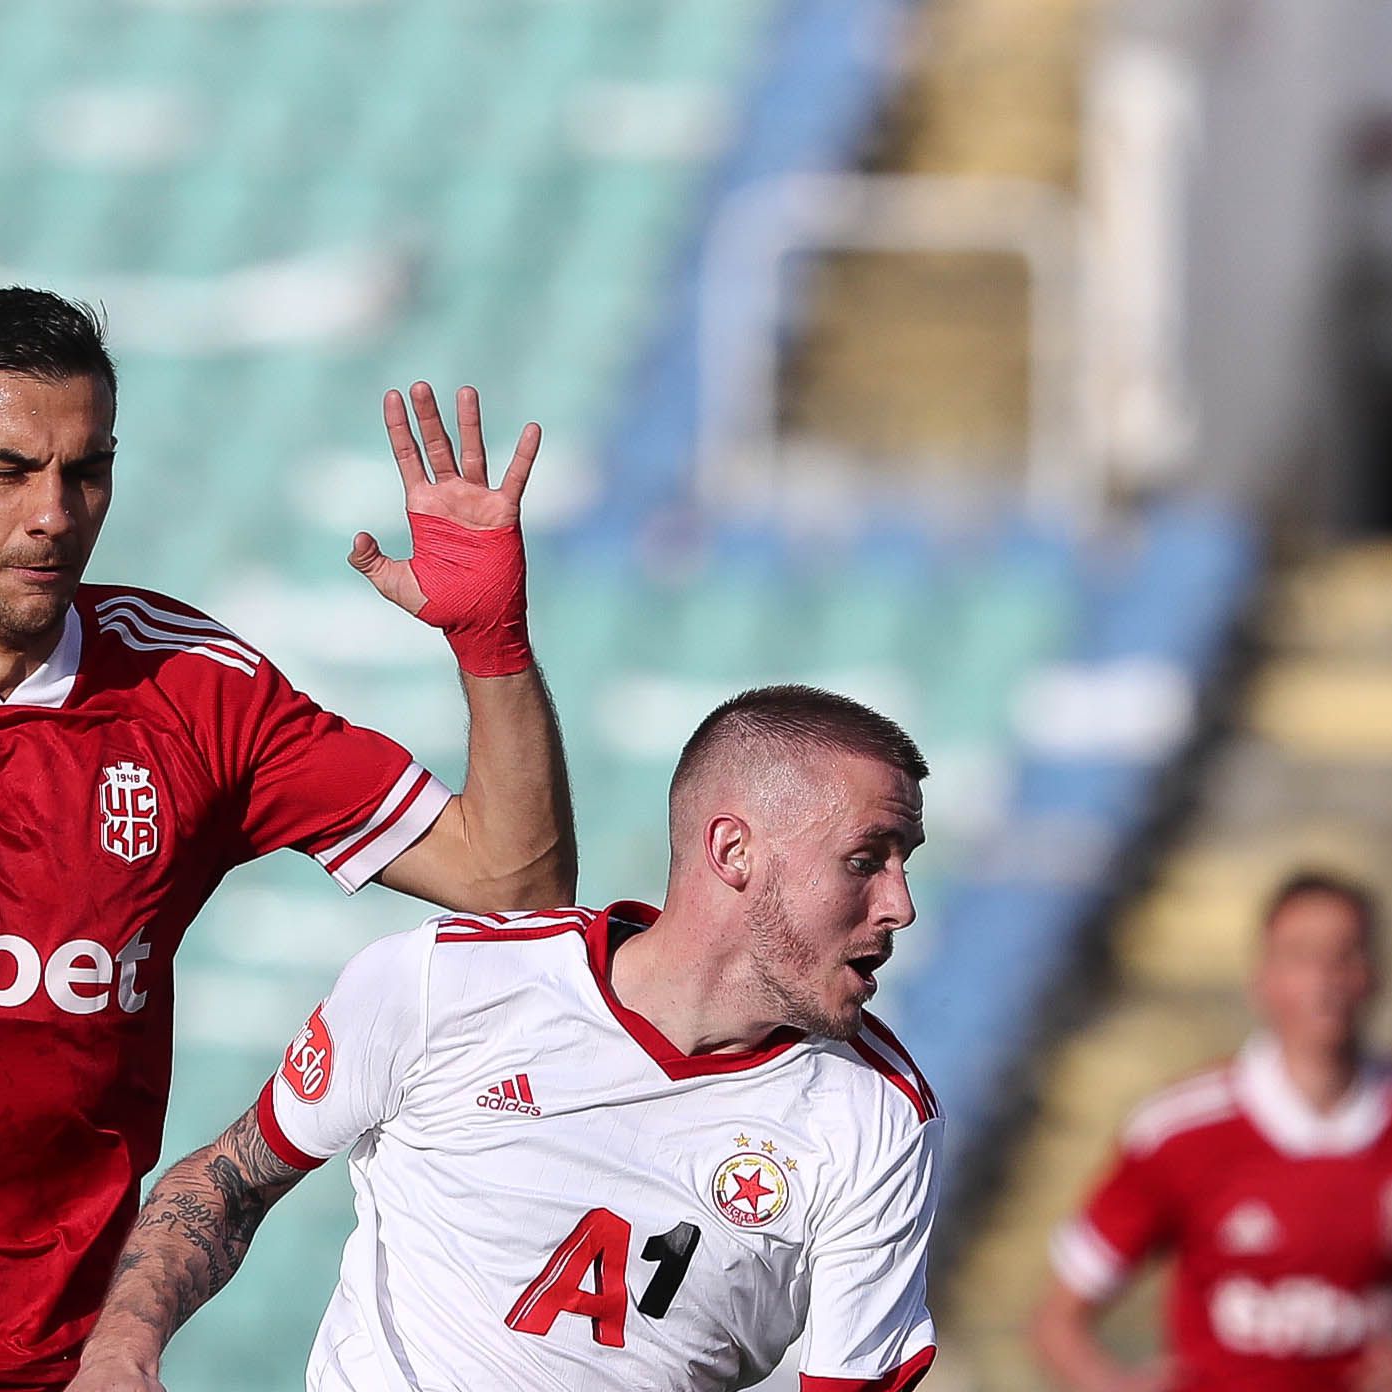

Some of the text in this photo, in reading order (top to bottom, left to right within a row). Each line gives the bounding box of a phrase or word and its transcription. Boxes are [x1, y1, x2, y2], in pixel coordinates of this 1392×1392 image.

[115, 773, 140, 783] 1948
[476, 1094, 542, 1117] adidas
[507, 1207, 701, 1348] A1
